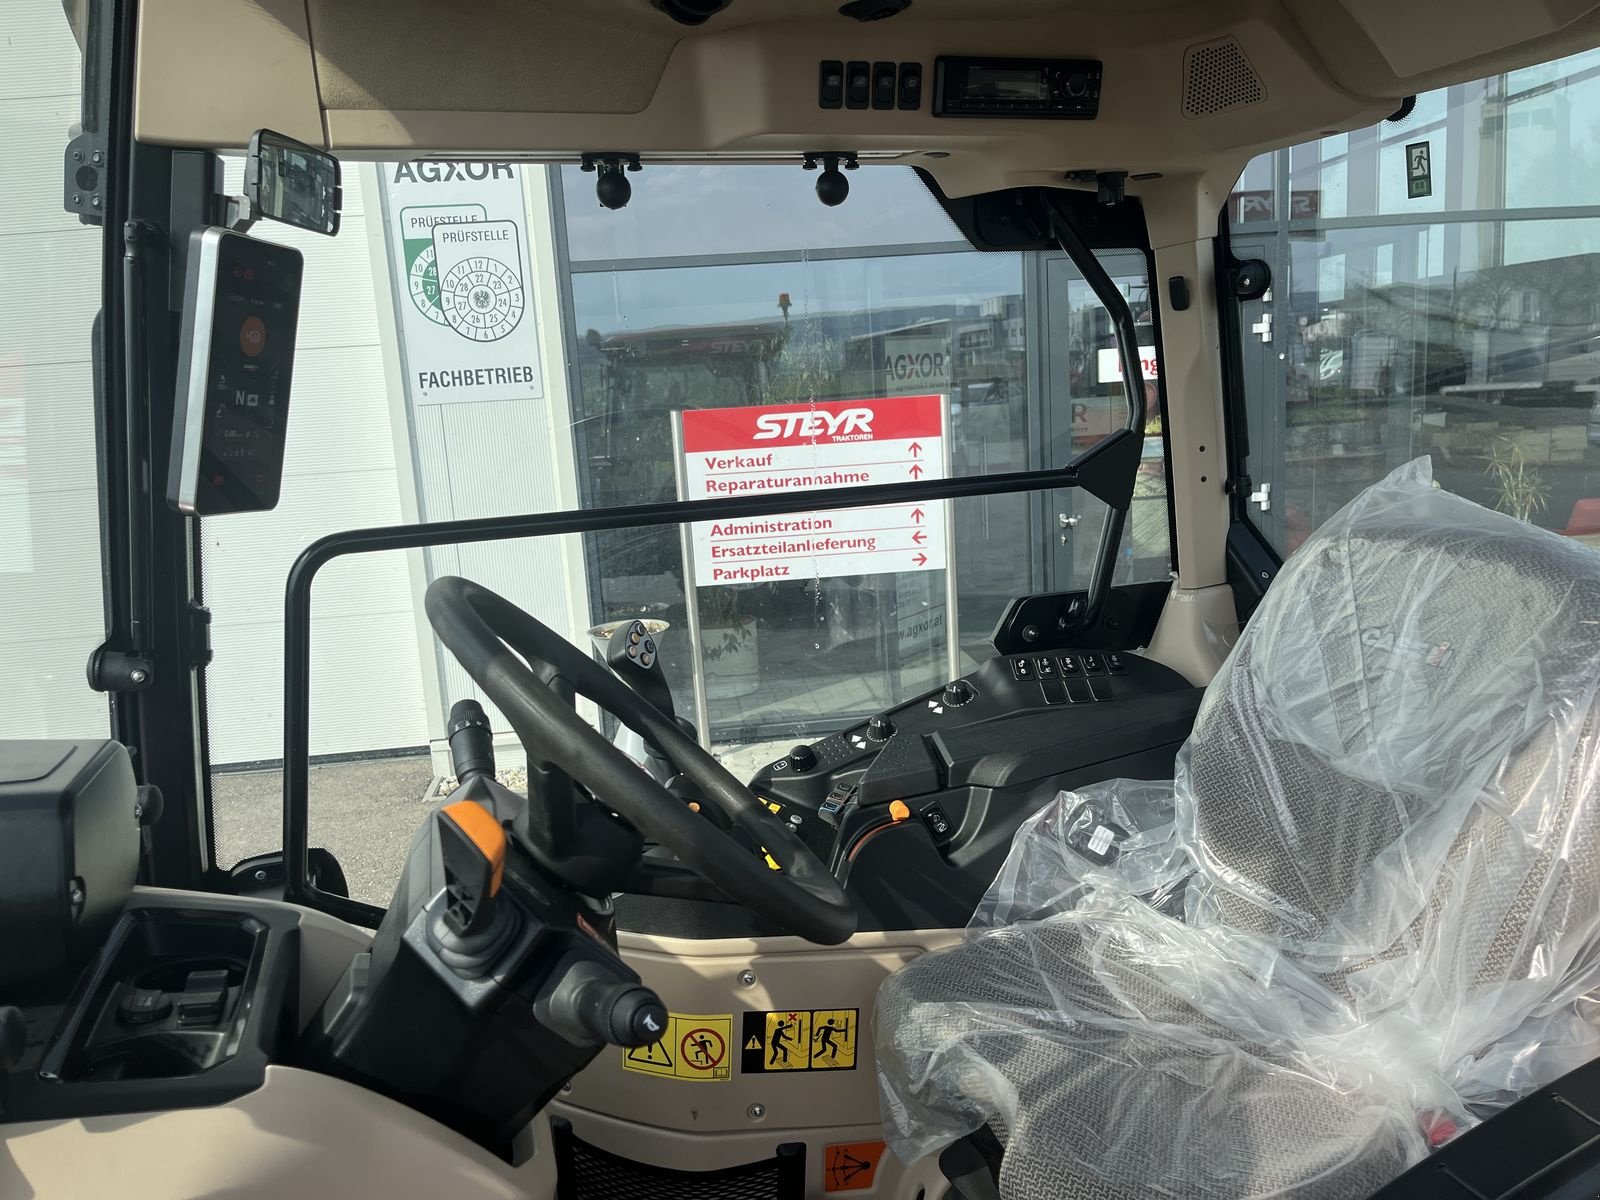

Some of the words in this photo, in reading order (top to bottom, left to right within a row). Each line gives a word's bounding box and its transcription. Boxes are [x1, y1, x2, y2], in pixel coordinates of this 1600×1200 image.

[393, 162, 515, 184] AGXOR
[442, 229, 510, 244] PRÜFSTELLE
[414, 264, 423, 273] 10
[474, 260, 483, 270] 12
[457, 266, 466, 275] 11
[474, 274, 485, 283] 22
[507, 275, 514, 285] 2
[414, 281, 419, 290] 9
[445, 279, 455, 289] 10
[459, 282, 469, 292] 28
[493, 281, 502, 290] 23
[426, 285, 436, 295] 27
[445, 297, 451, 306] 9
[498, 298, 507, 308] 24
[515, 293, 520, 303] 3
[421, 299, 426, 309] 8
[457, 301, 467, 311] 27
[452, 314, 457, 324] 8
[471, 314, 481, 324] 26
[489, 313, 499, 323] 25
[511, 310, 516, 320] 4
[483, 330, 489, 340] 6
[418, 366, 534, 389] FACHBETRIEB
[753, 408, 874, 440] STEYR
[832, 433, 874, 443] TRAKTOREN
[705, 453, 774, 470] Verkauf
[705, 470, 870, 494] Reparaturannahme
[710, 517, 833, 537] Administration
[711, 535, 877, 559] Ersatzteilanlieferung
[712, 564, 791, 581] Parkplatz
